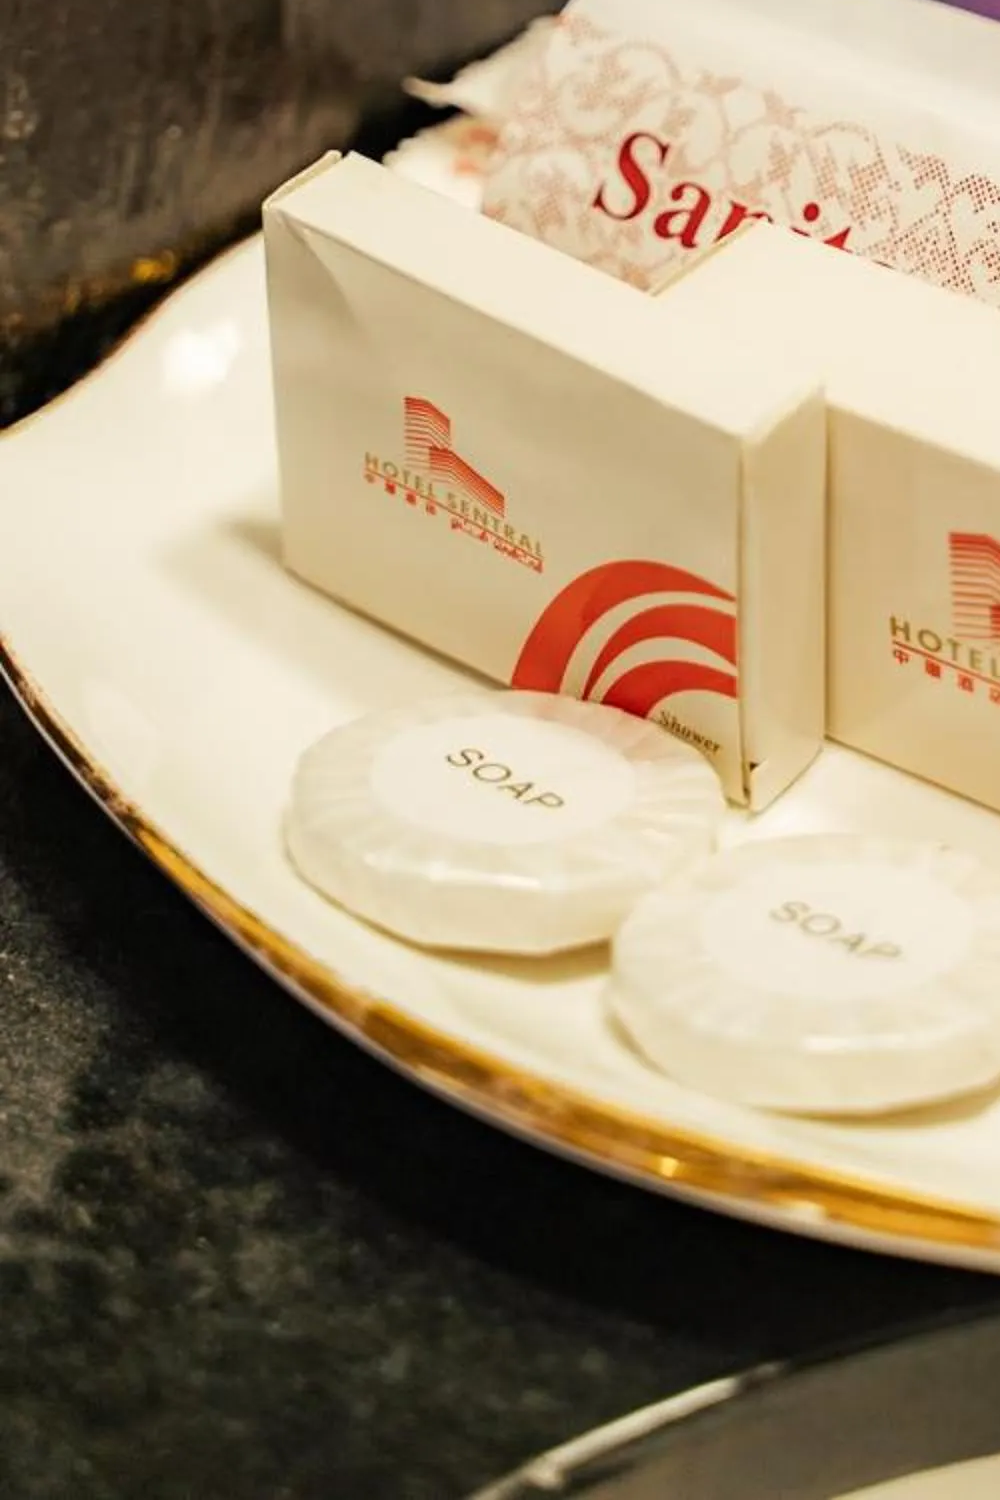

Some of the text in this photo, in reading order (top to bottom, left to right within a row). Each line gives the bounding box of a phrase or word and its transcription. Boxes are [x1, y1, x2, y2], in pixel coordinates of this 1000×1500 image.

[364, 451, 437, 497] HOTEL
[447, 491, 544, 557] SENTRAL
[445, 747, 566, 811] SOAP
[768, 900, 903, 963] SOAP
